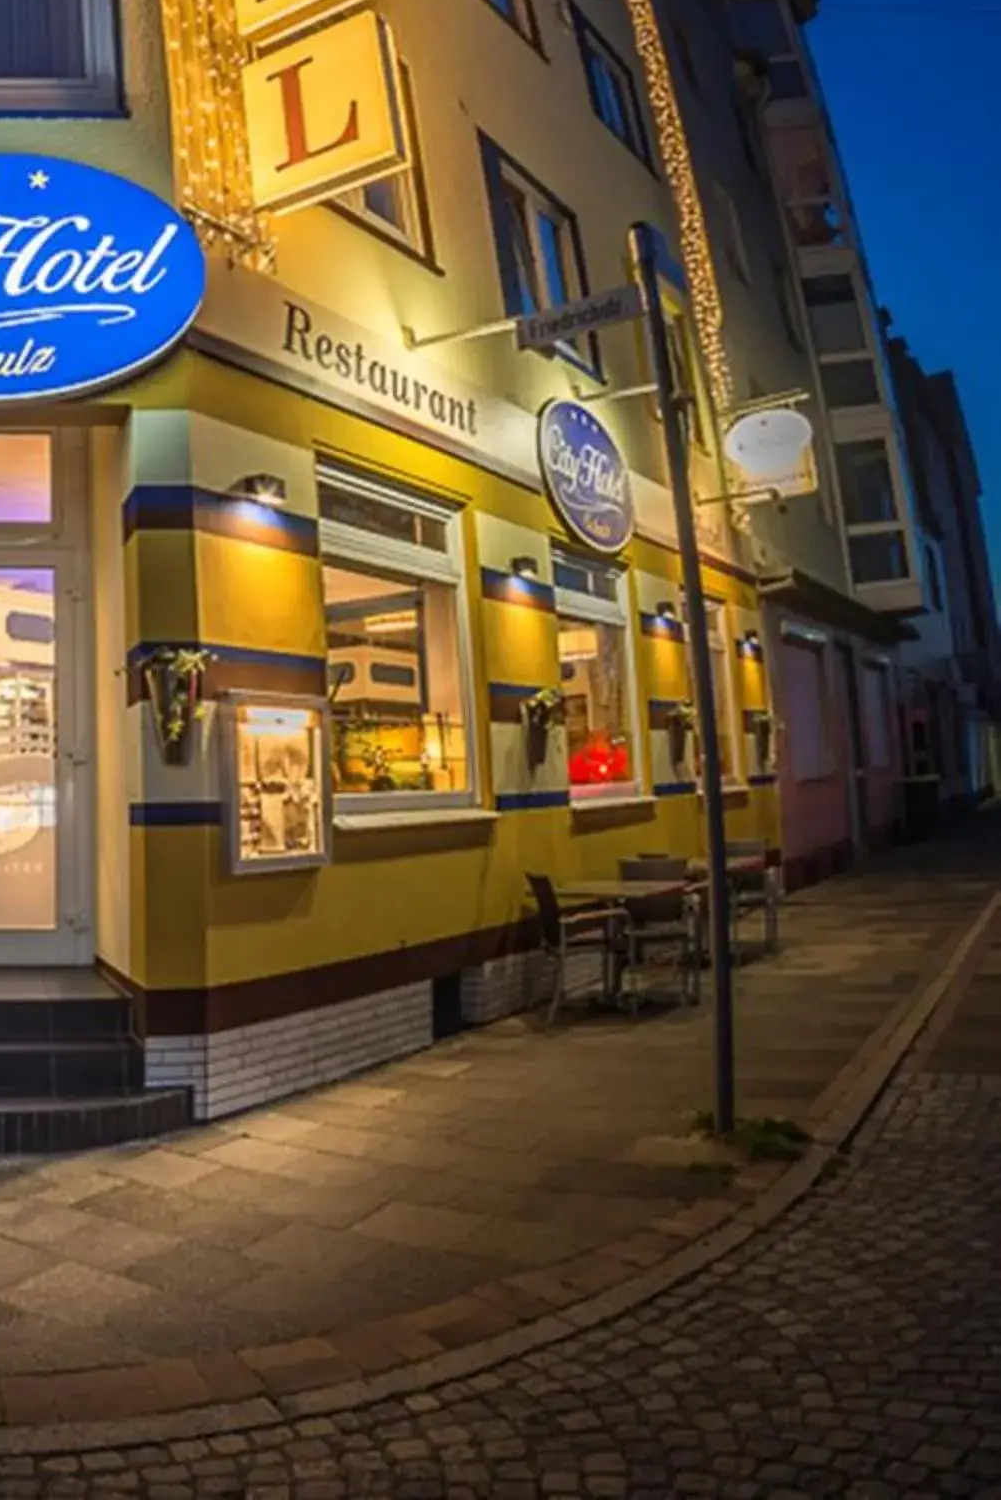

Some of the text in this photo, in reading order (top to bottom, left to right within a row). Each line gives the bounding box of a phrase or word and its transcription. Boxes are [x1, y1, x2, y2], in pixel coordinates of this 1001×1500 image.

[282, 299, 478, 436] Restaurant
[548, 423, 627, 503] City Hotel
